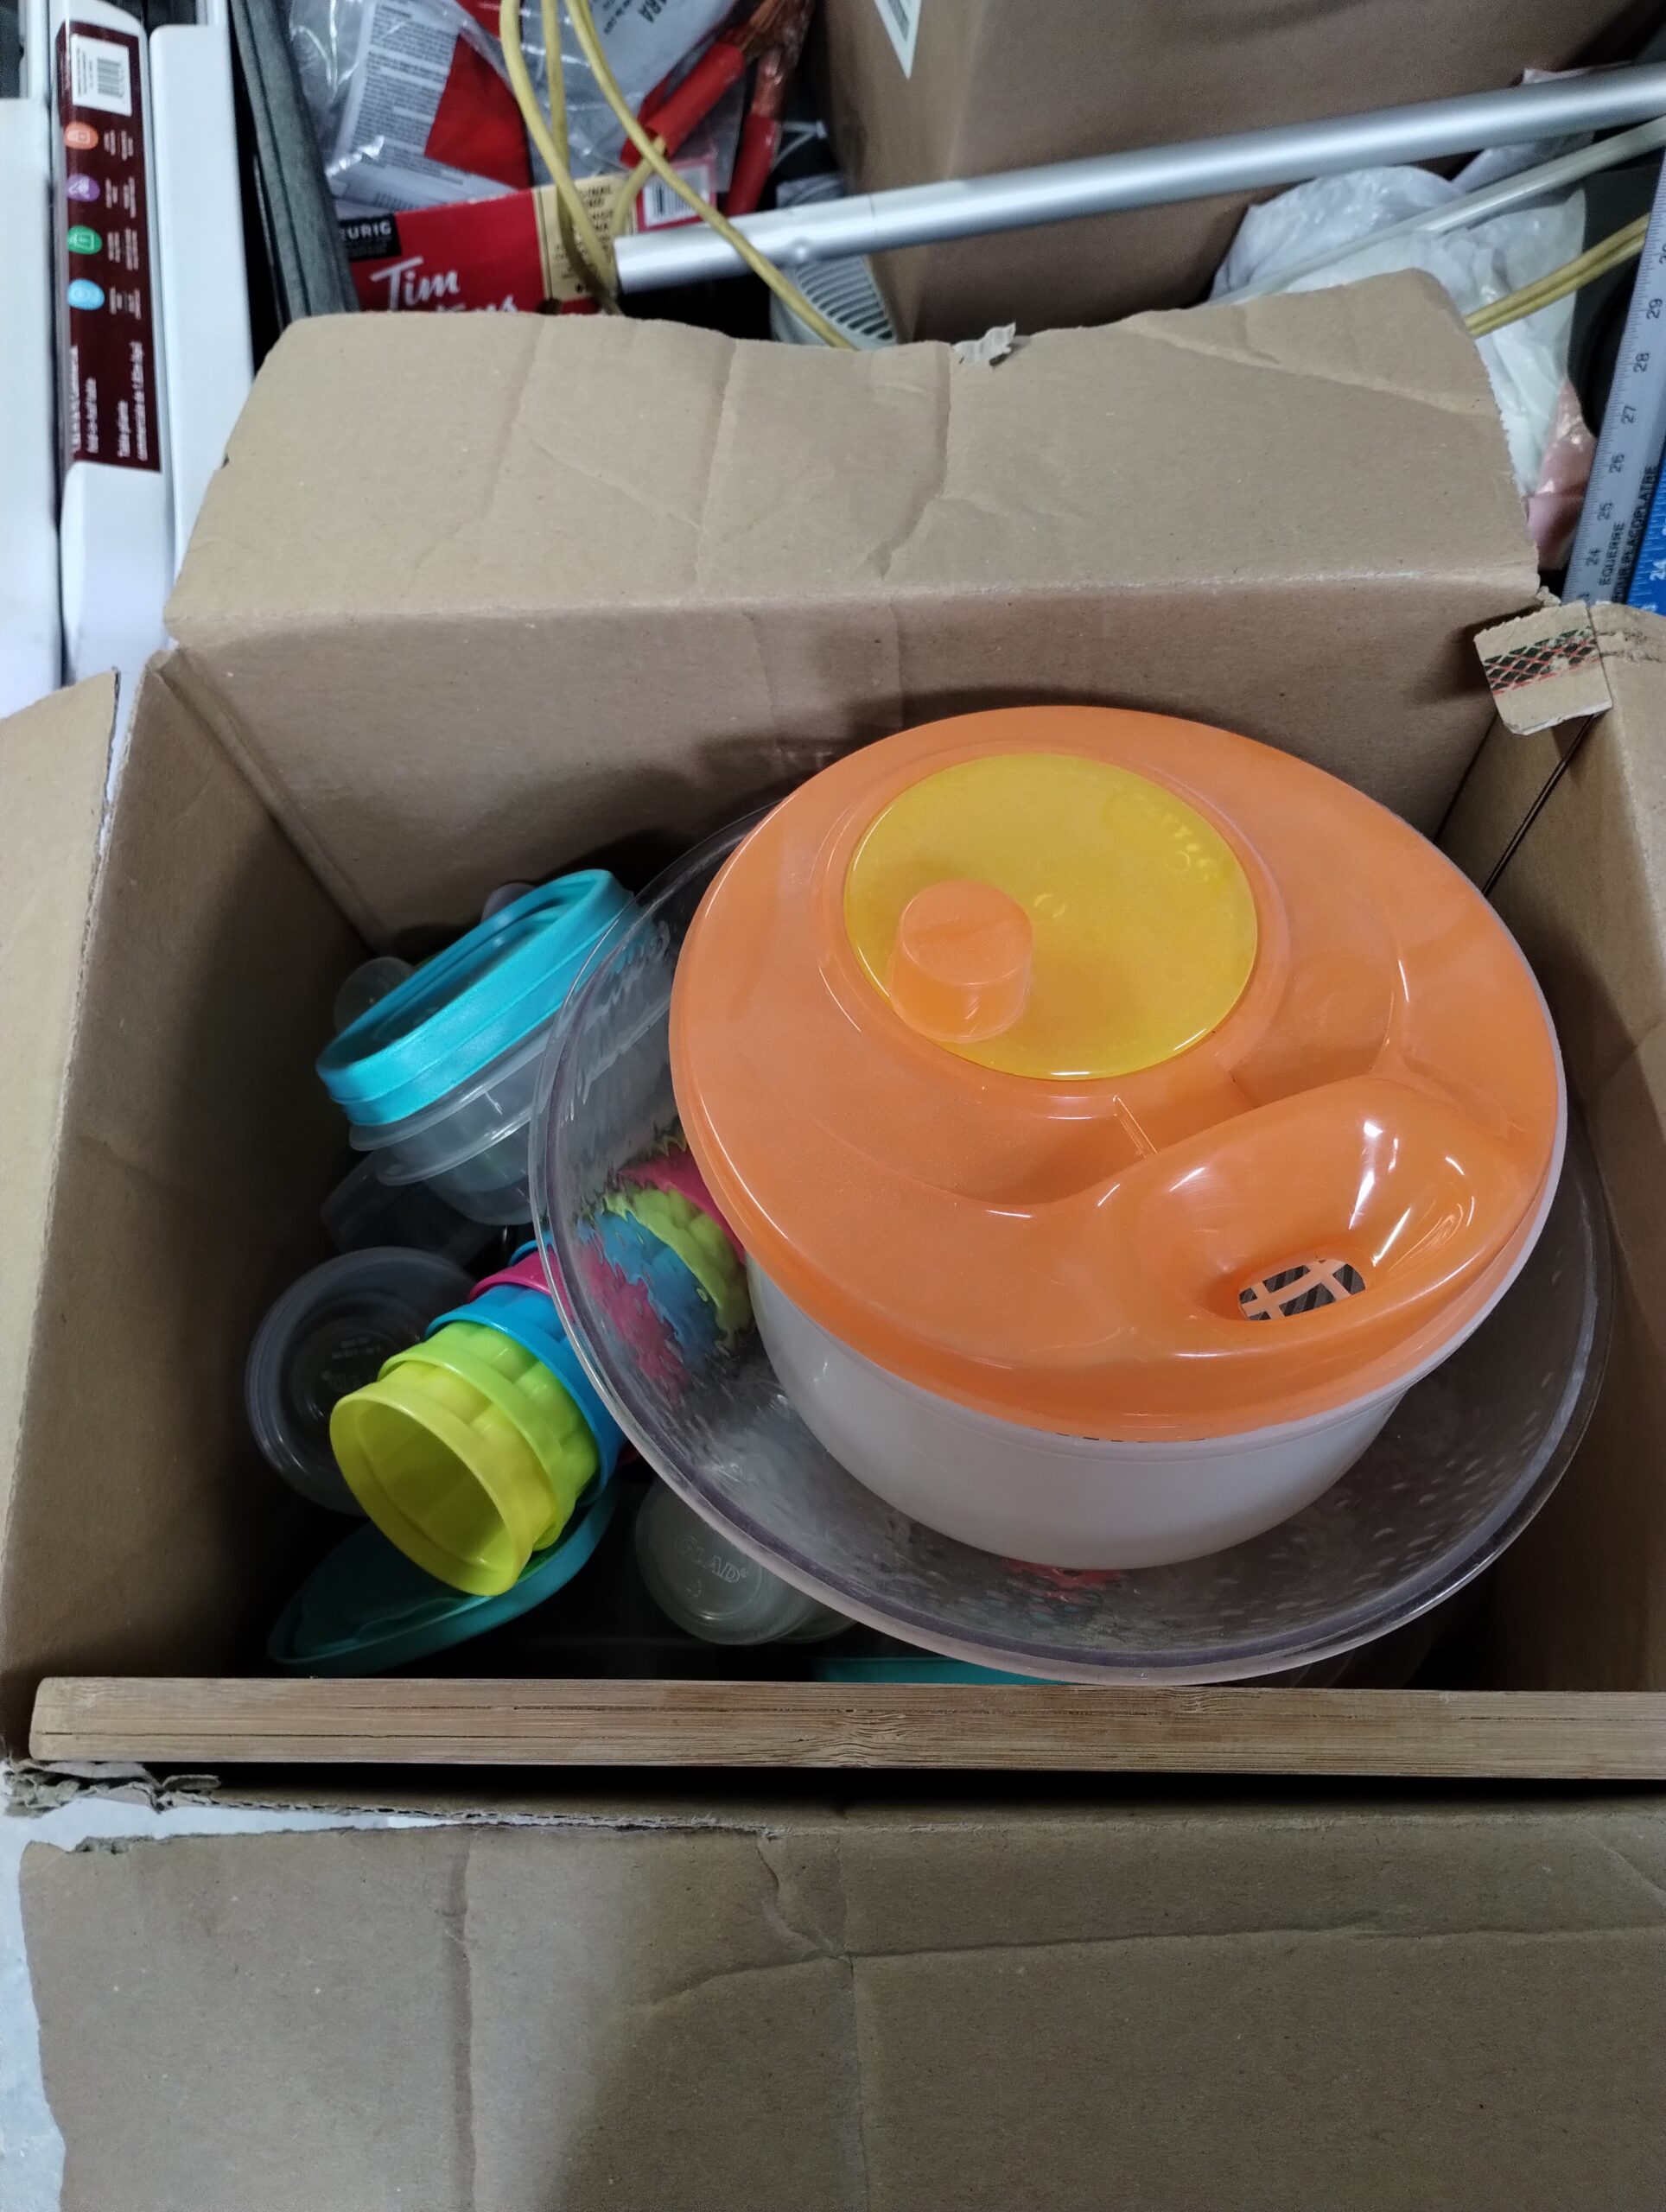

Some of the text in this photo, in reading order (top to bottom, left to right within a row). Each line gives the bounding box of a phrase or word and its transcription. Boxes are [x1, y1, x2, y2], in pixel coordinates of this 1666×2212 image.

[369, 255, 460, 312] Tim
[1645, 297, 1663, 320] 29
[1633, 352, 1650, 372] 28
[1621, 405, 1637, 424] 27
[1608, 453, 1625, 473] 26
[1598, 501, 1613, 520] 25
[1586, 548, 1601, 566] 24
